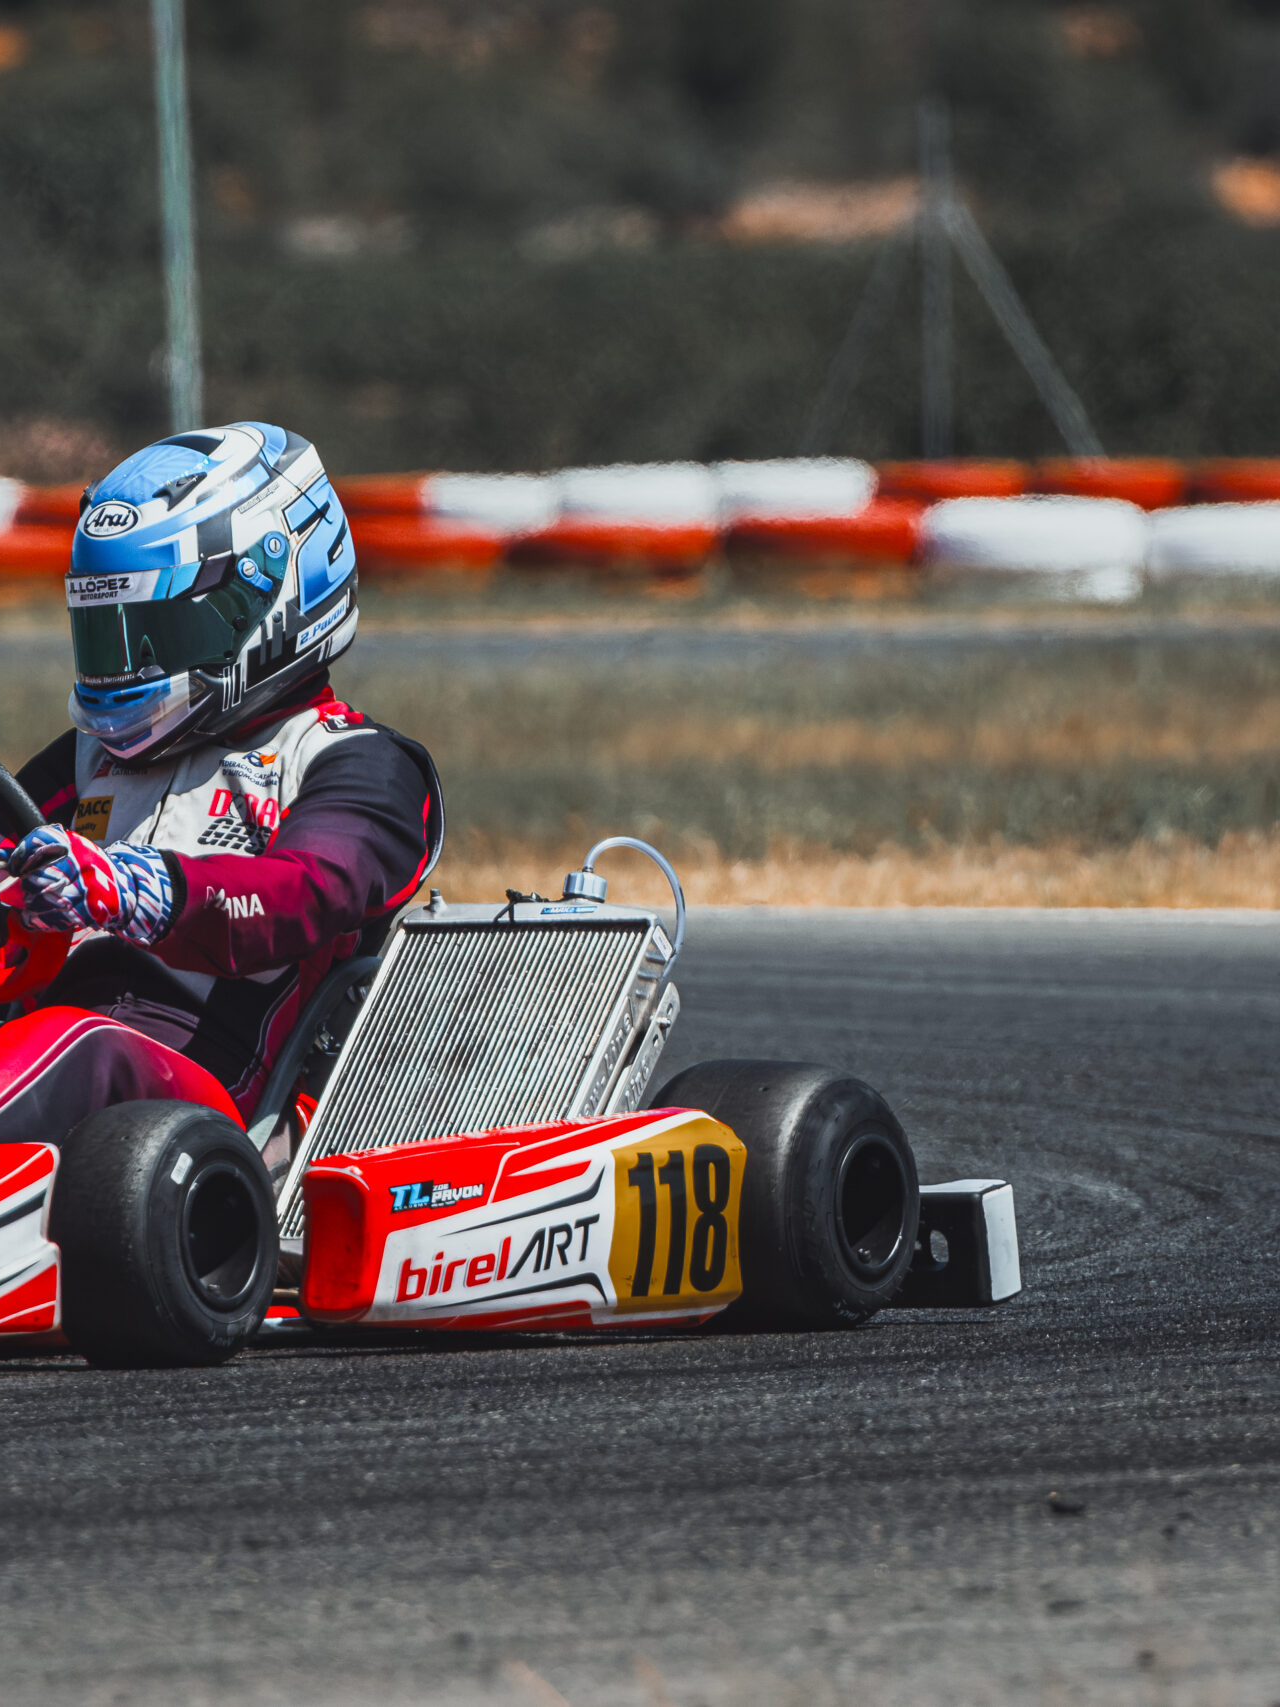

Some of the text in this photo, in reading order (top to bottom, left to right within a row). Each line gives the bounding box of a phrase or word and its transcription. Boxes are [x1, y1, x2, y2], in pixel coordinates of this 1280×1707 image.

[85, 507, 131, 528] Arai
[77, 800, 110, 818] RACC
[389, 1182, 430, 1208] TL
[431, 1184, 484, 1203] PAVON
[628, 1144, 731, 1297] 118
[394, 1214, 600, 1303] birelART
